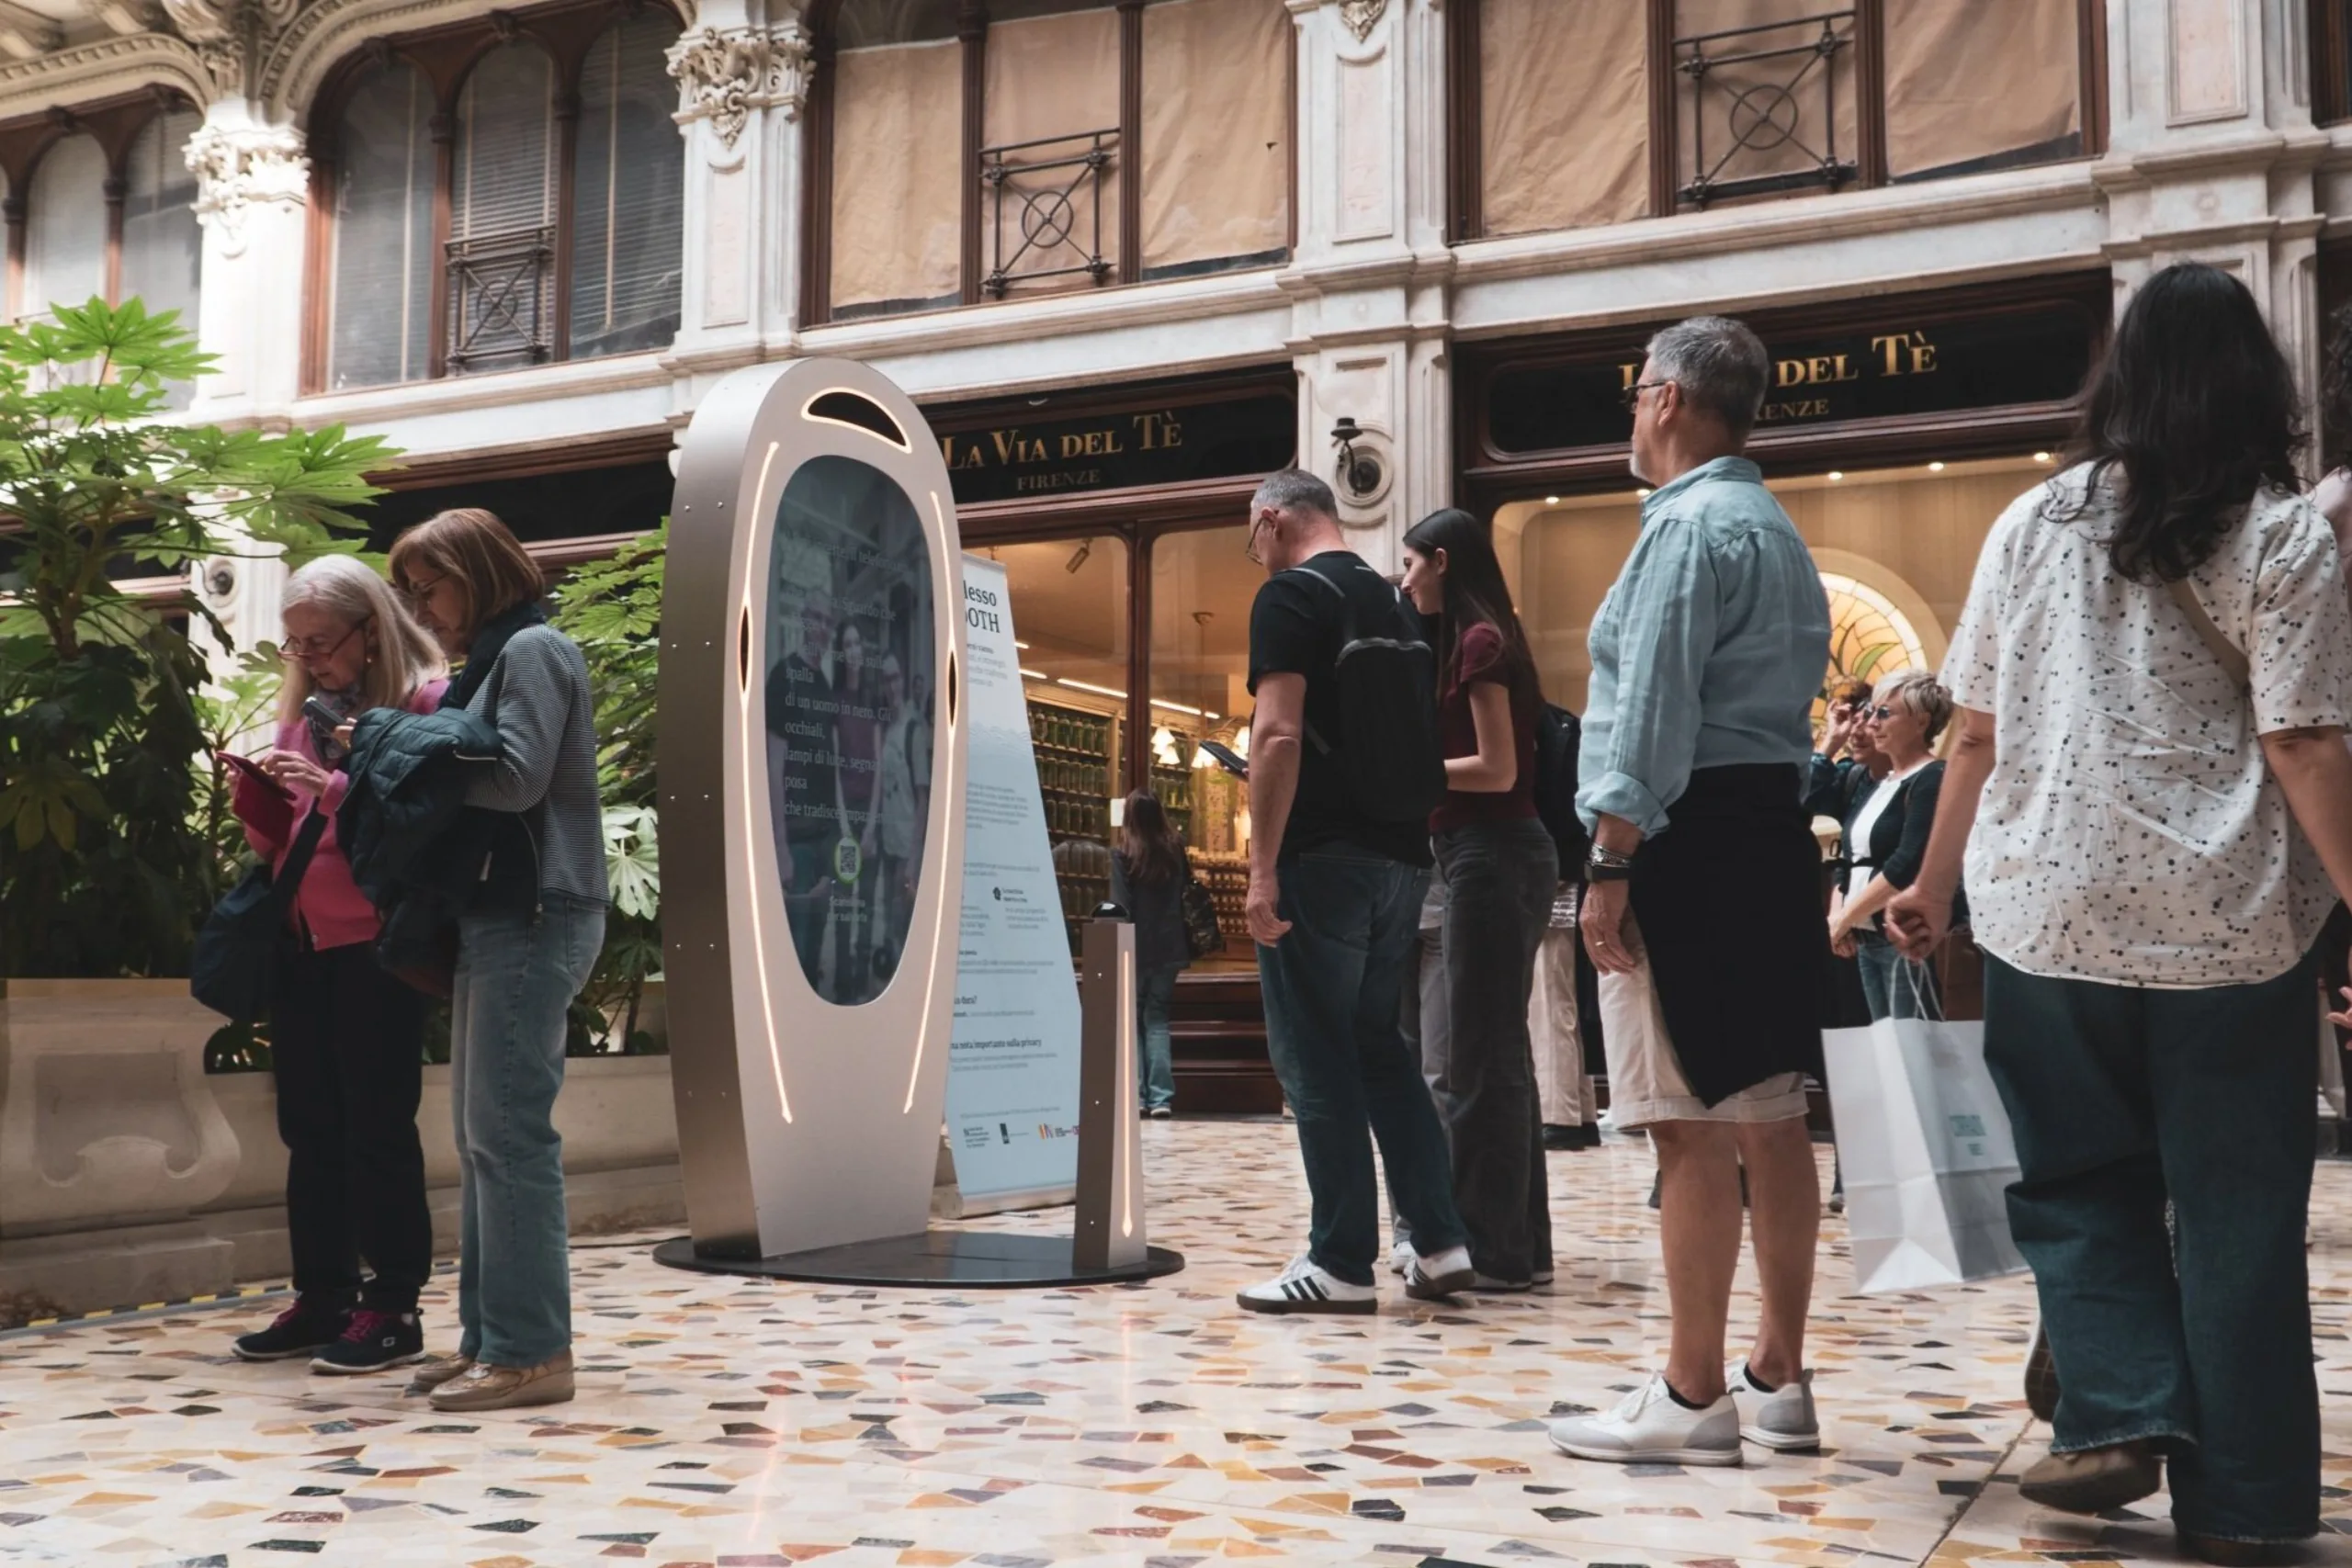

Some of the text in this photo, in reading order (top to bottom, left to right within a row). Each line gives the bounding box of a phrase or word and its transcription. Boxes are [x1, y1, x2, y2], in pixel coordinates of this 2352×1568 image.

[1775, 354, 1859, 388] DEL
[1871, 330, 1938, 377] TÈ
[941, 410, 1182, 470] LA VIA DEL TÈ
[1017, 468, 1101, 491] FIRENZE
[966, 607, 1001, 634] OTH
[786, 667, 815, 683] spalla
[785, 690, 796, 706] di
[797, 696, 810, 710] un
[812, 699, 840, 715] uomo
[841, 700, 851, 716] in
[853, 705, 876, 720] nero.
[785, 720, 826, 740] occhiali,
[815, 749, 824, 764] di
[785, 775, 808, 791] posa
[785, 800, 801, 817] che
